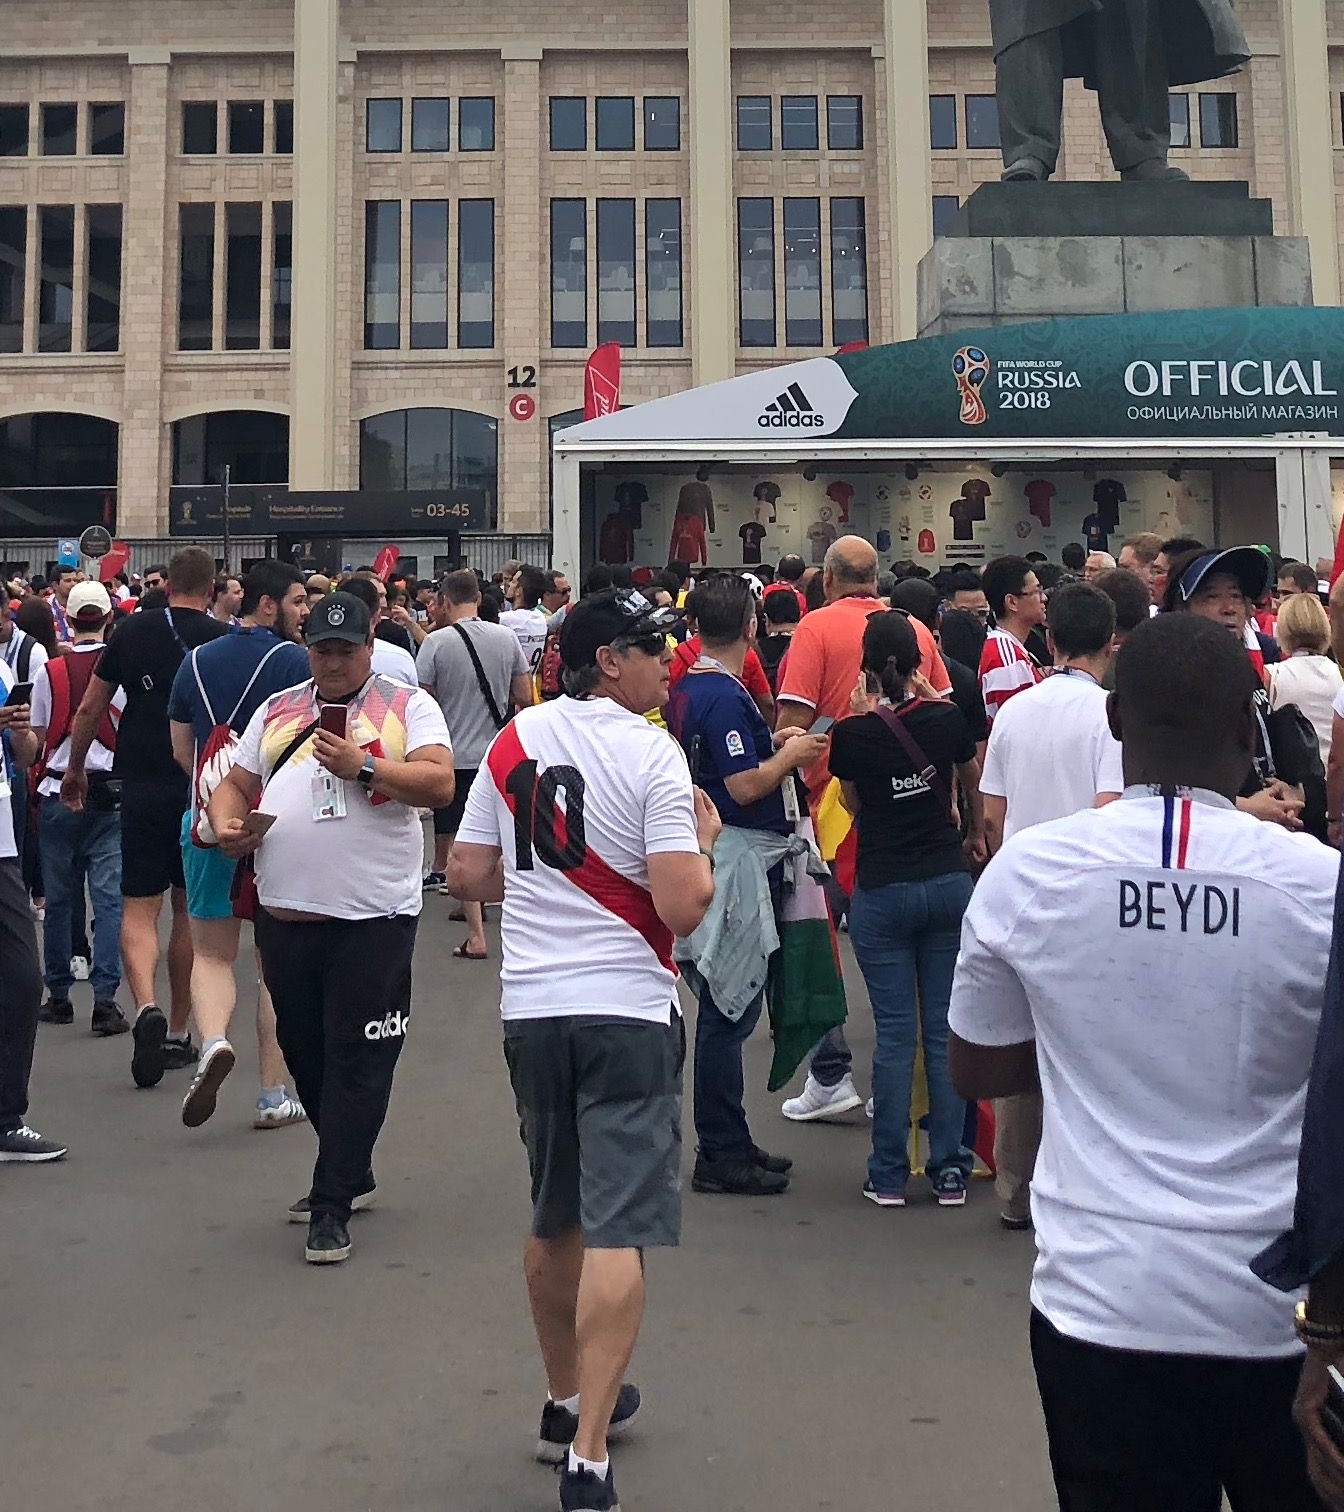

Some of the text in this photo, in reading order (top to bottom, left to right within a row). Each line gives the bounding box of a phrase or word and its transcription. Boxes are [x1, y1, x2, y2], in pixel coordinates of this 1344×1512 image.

[507, 366, 536, 388] 12
[998, 371, 1081, 388] RUSSIA
[1124, 360, 1338, 396] OFFICIAL
[999, 391, 1051, 409] 2018
[758, 410, 824, 427] adidas
[1127, 403, 1338, 421] ОФИЦИАЛЬНЫЙ МАГАЗИН
[427, 503, 470, 517] 03-45
[506, 759, 586, 870] 10
[1119, 879, 1239, 937] BEYDI
